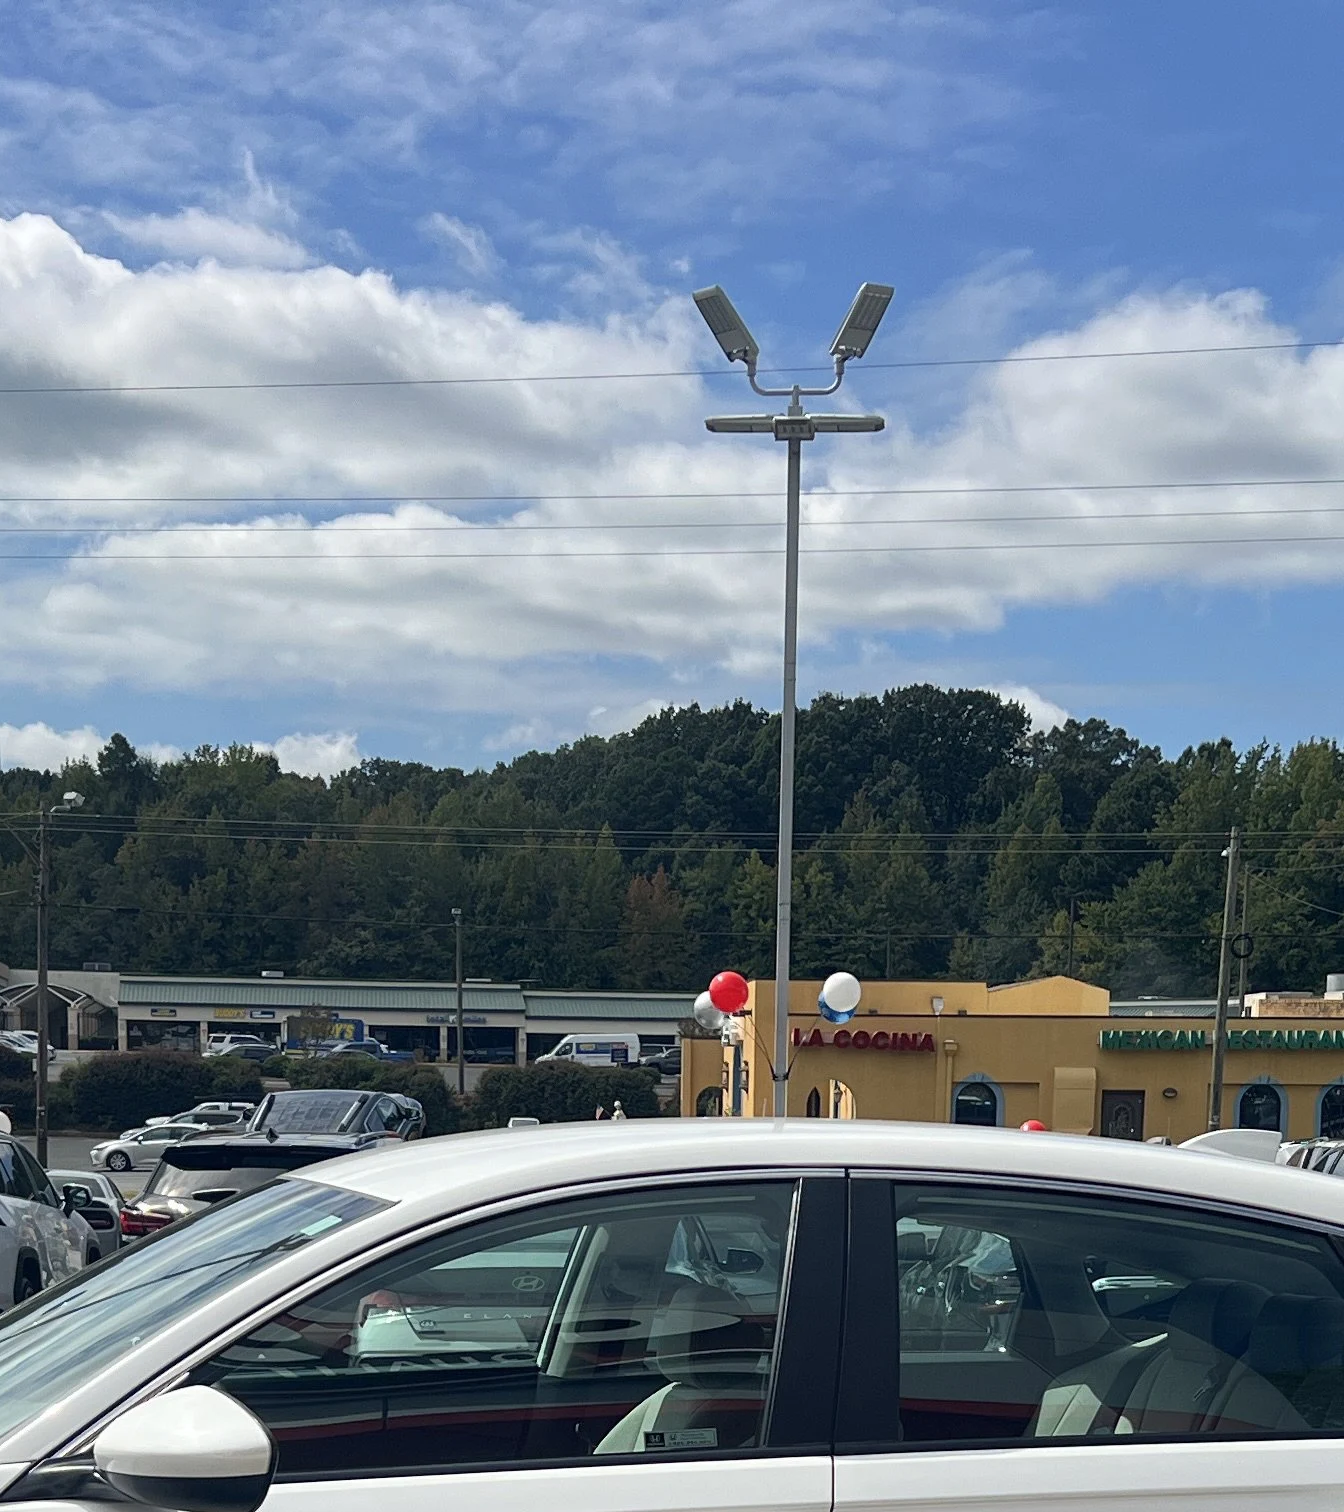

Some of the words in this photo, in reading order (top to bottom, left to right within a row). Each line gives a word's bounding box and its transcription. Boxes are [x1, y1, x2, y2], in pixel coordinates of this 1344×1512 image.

[791, 1028, 824, 1047] LA
[833, 1029, 936, 1052] COCINA
[1100, 1030, 1205, 1049] MEXICAN
